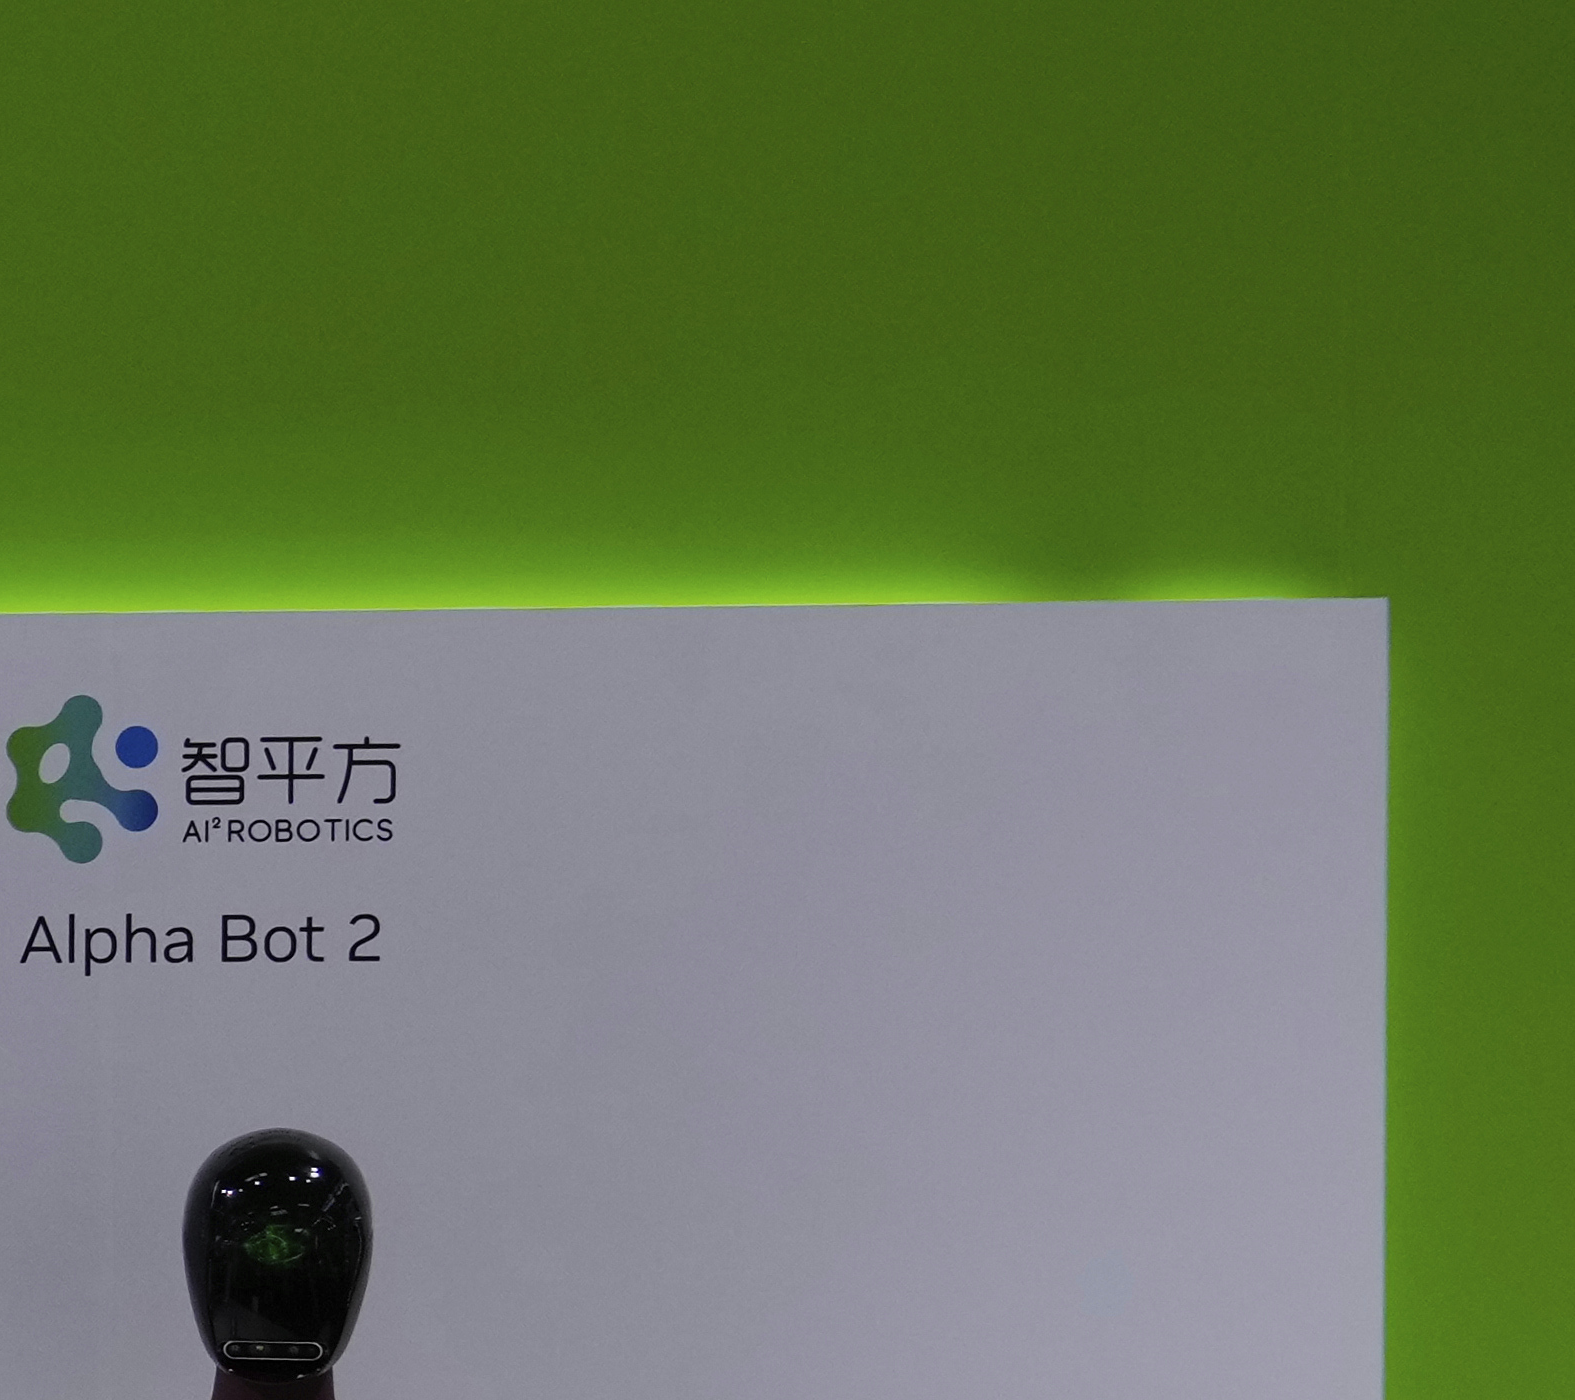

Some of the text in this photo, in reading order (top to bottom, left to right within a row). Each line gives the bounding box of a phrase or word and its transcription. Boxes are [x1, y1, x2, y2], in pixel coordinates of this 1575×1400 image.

[181, 736, 403, 807] 智平方
[20, 913, 382, 978] Alpha Bot 2
